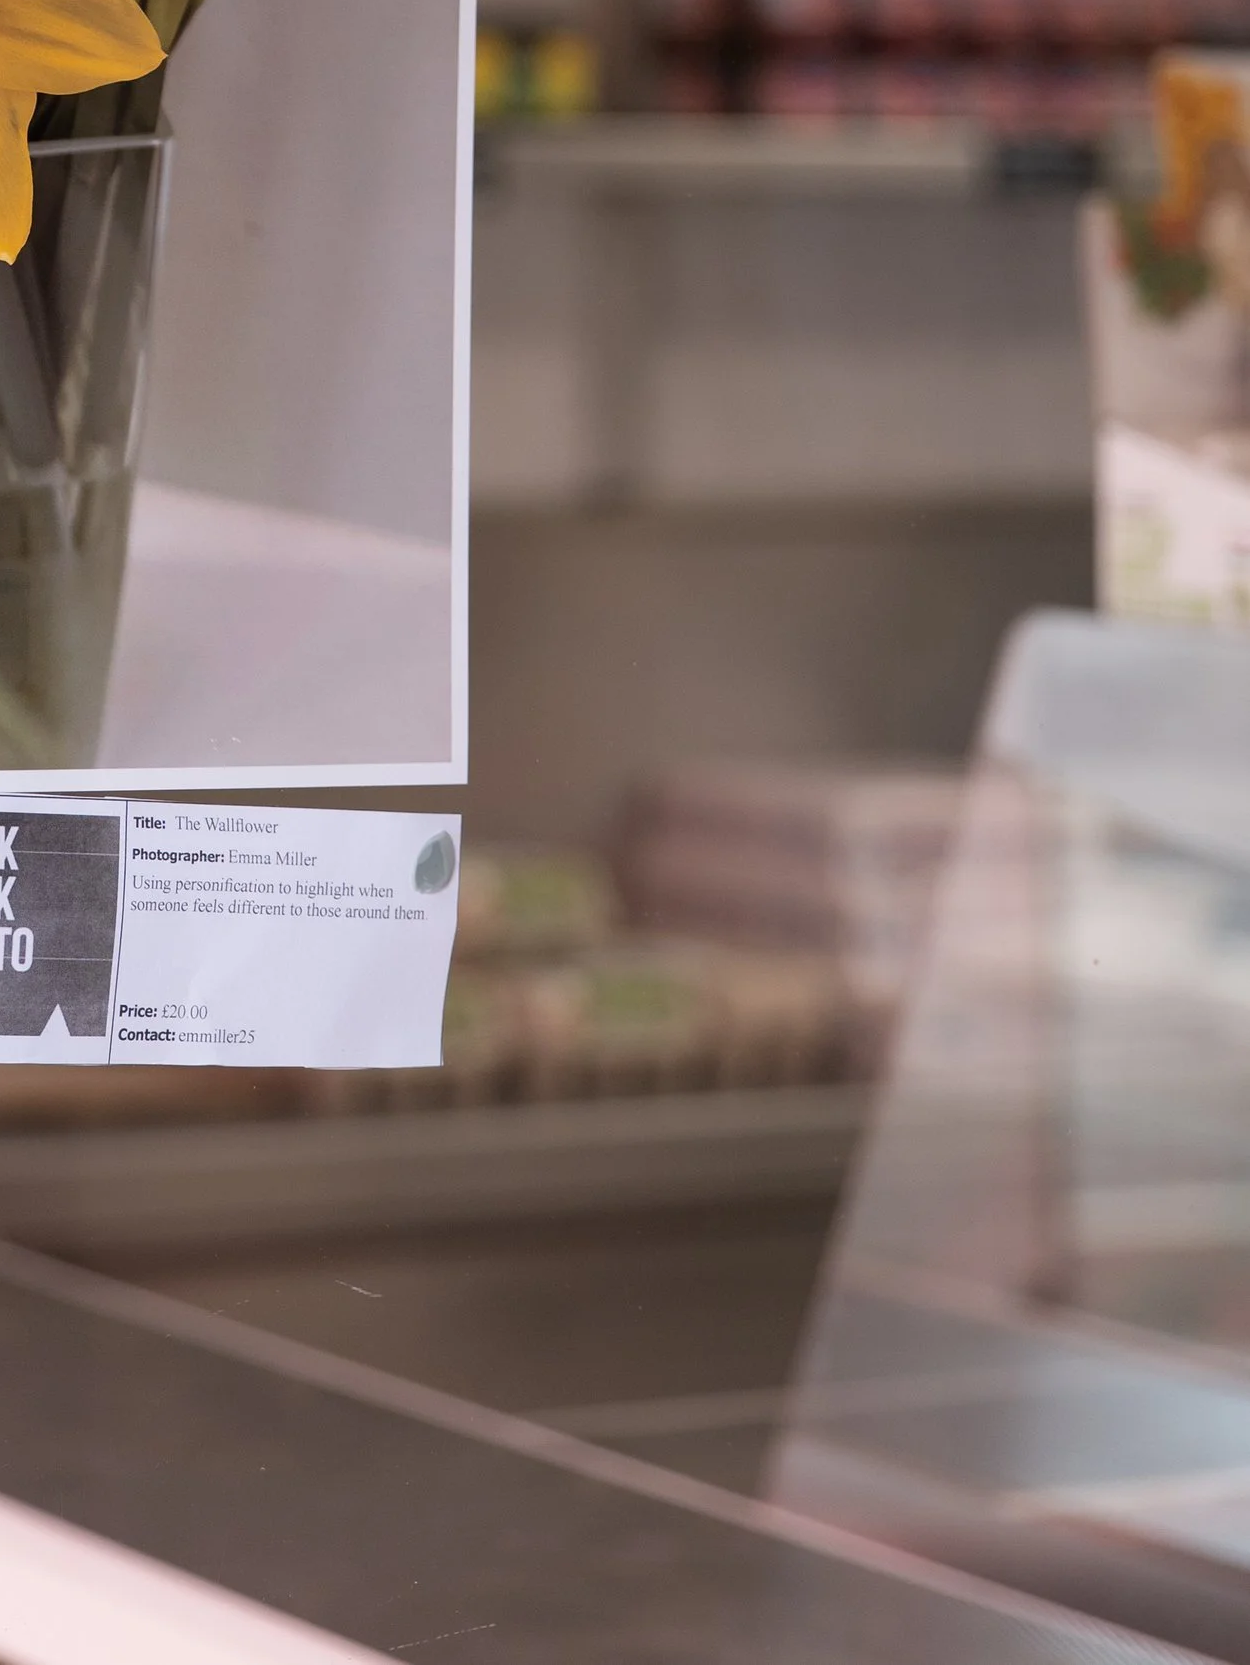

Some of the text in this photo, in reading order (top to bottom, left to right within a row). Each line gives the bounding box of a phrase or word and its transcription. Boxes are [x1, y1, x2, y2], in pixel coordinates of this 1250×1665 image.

[133, 816, 278, 833] Title: The Wallflower
[132, 848, 317, 866] Photographer: Emma Miller
[133, 875, 393, 899] Using personification to highlight when
[130, 898, 427, 920] someone feels different to those around them.
[119, 1004, 207, 1019] Price: £20.00
[118, 1028, 255, 1044] Contact: emmiller25
